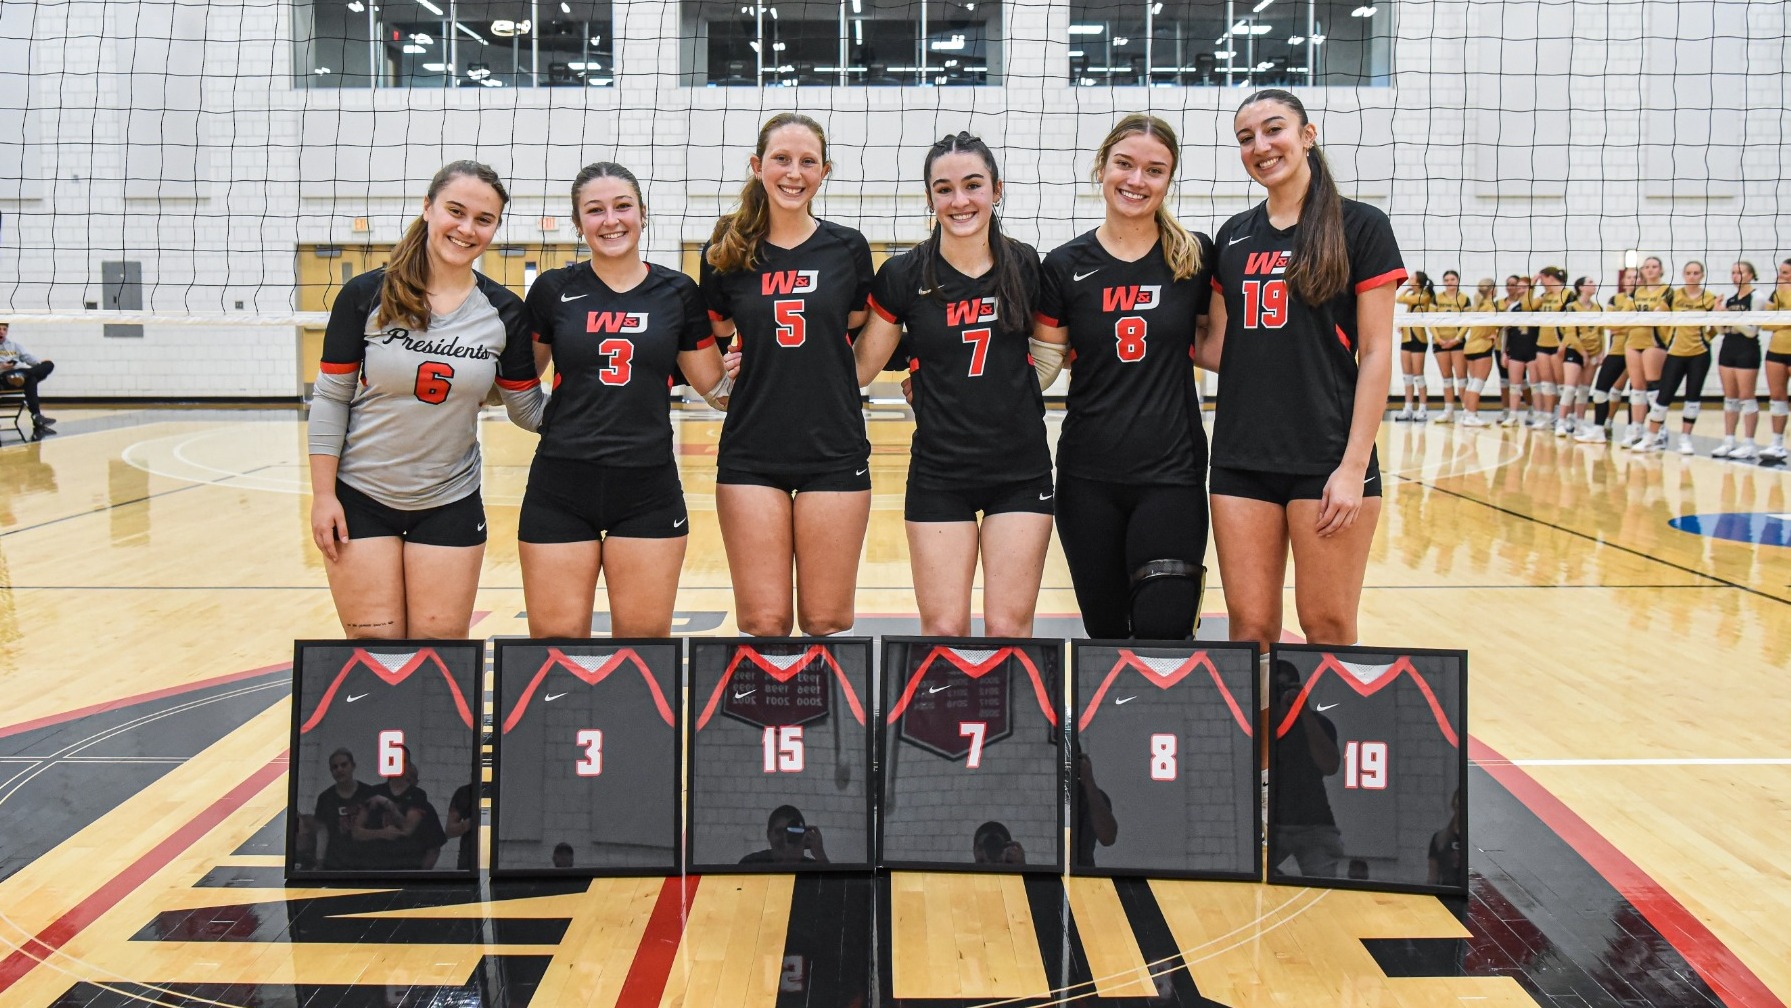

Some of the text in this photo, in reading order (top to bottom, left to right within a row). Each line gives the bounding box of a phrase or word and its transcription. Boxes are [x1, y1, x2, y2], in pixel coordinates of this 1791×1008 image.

[761, 269, 819, 296] W&J
[1102, 284, 1162, 312] W&J
[1242, 280, 1289, 329] 19
[382, 327, 491, 360] Presidents
[586, 311, 650, 334] W&J
[774, 299, 806, 348] 5
[1115, 316, 1148, 363] 8
[598, 338, 635, 387] 3
[961, 327, 992, 378] 7
[414, 360, 455, 406] 6
[378, 729, 405, 777] 6
[576, 728, 603, 776] 3
[762, 725, 805, 773] 15
[959, 721, 987, 769] 7
[1150, 733, 1177, 781] 8
[1344, 740, 1388, 790] 19
